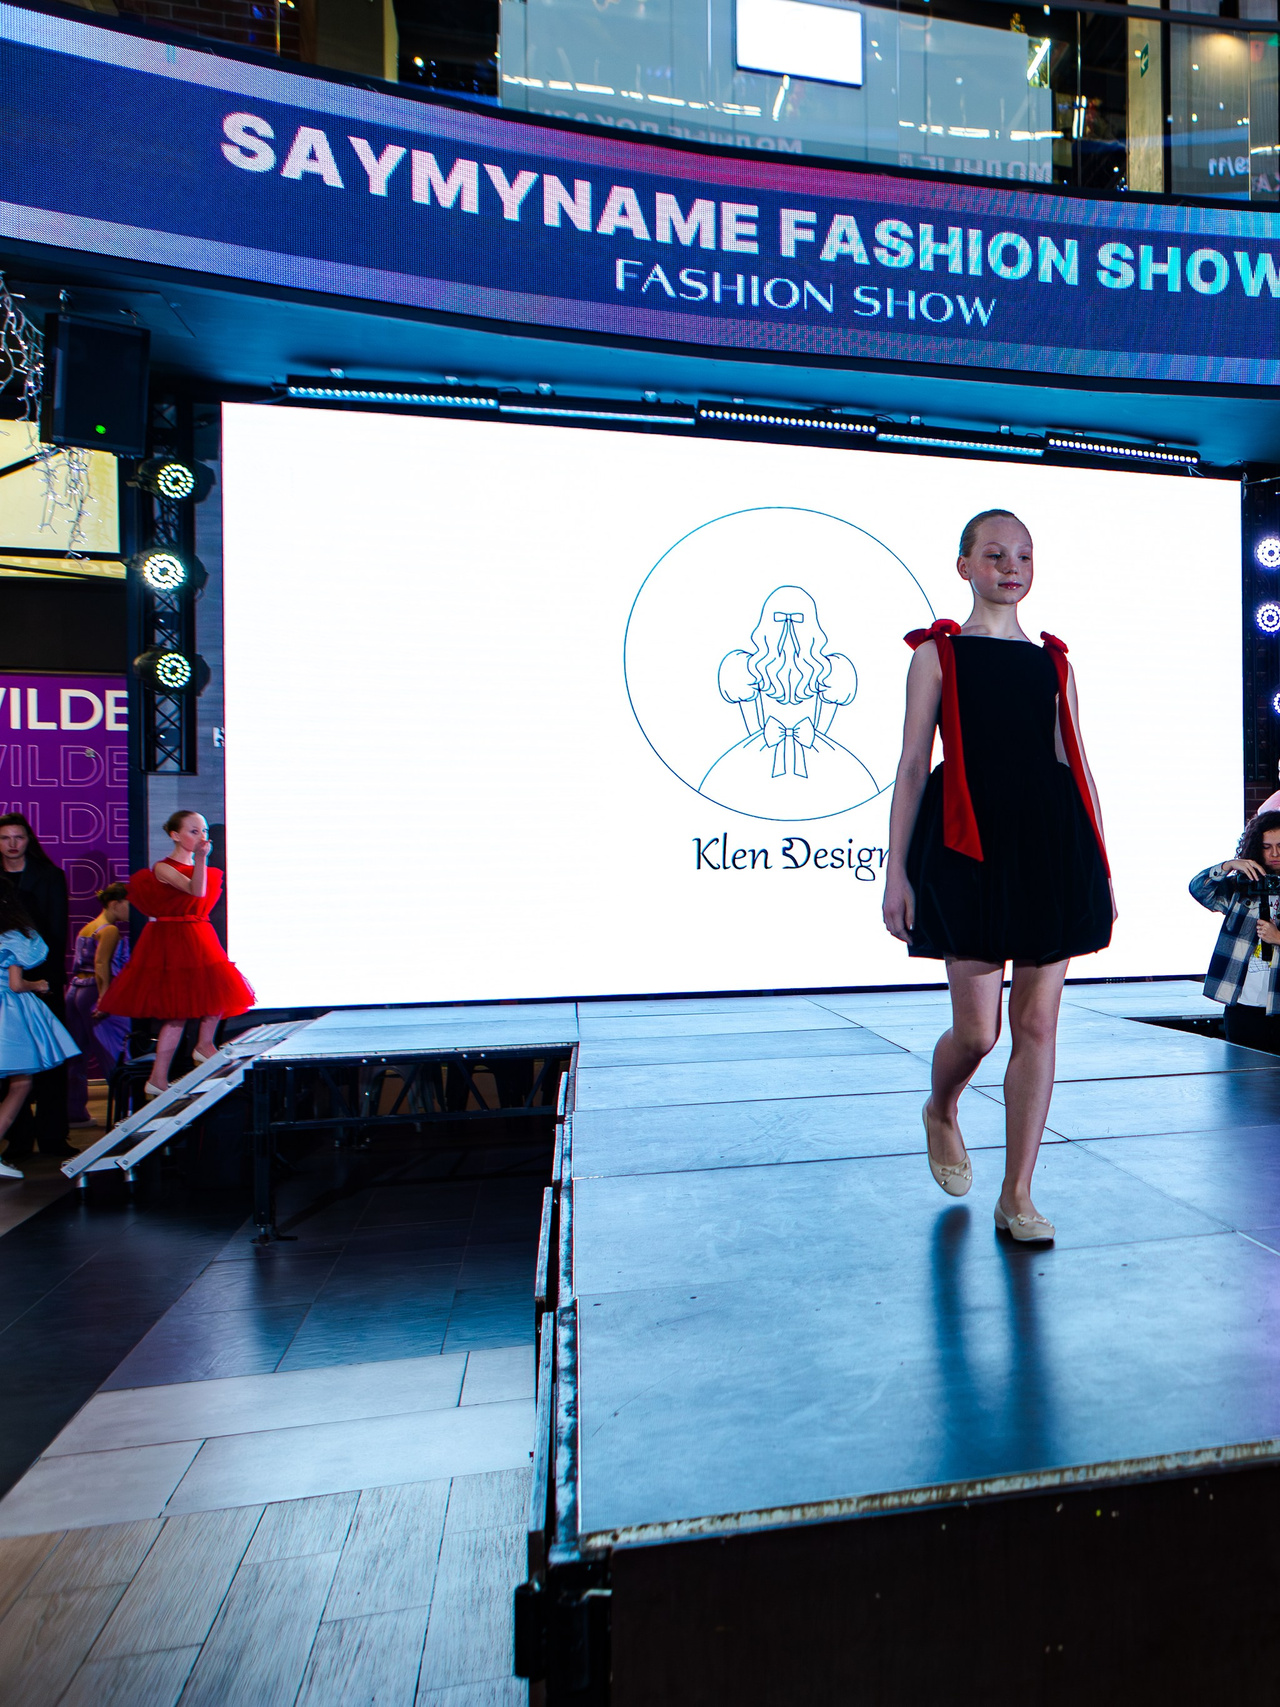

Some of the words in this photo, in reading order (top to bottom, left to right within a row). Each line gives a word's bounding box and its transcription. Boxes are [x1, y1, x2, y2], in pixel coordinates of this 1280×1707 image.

[220, 111, 759, 255] SAYMYNAME
[779, 207, 1079, 286] FASHION
[615, 258, 834, 314] FASHION
[853, 285, 997, 327] SHOW
[0, 687, 129, 731] ILDE
[692, 832, 773, 870] Klen
